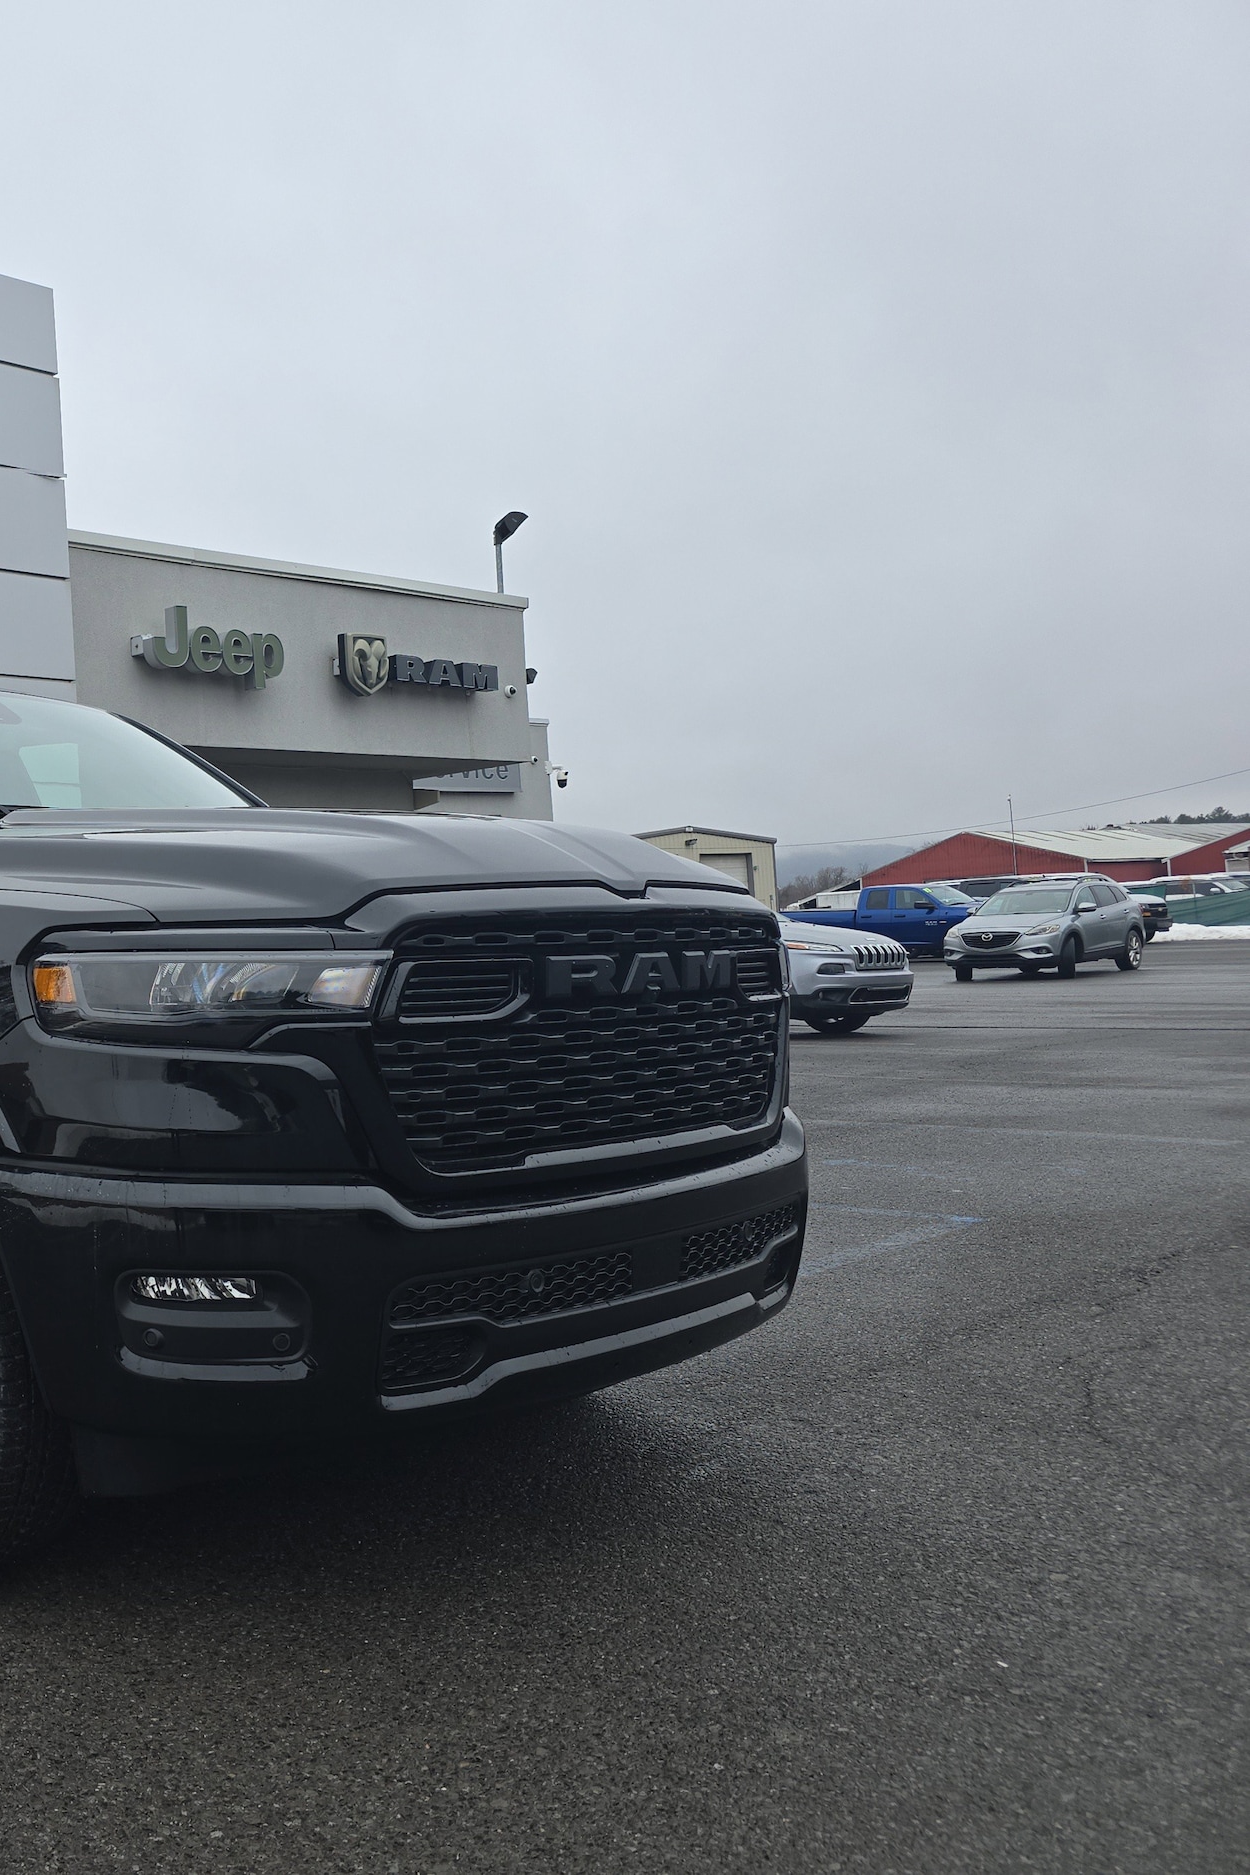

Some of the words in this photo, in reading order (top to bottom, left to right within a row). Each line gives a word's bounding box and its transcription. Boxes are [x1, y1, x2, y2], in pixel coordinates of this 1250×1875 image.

[144, 605, 284, 690] Jeep
[390, 653, 499, 692] RAM
[545, 950, 732, 997] RAM
